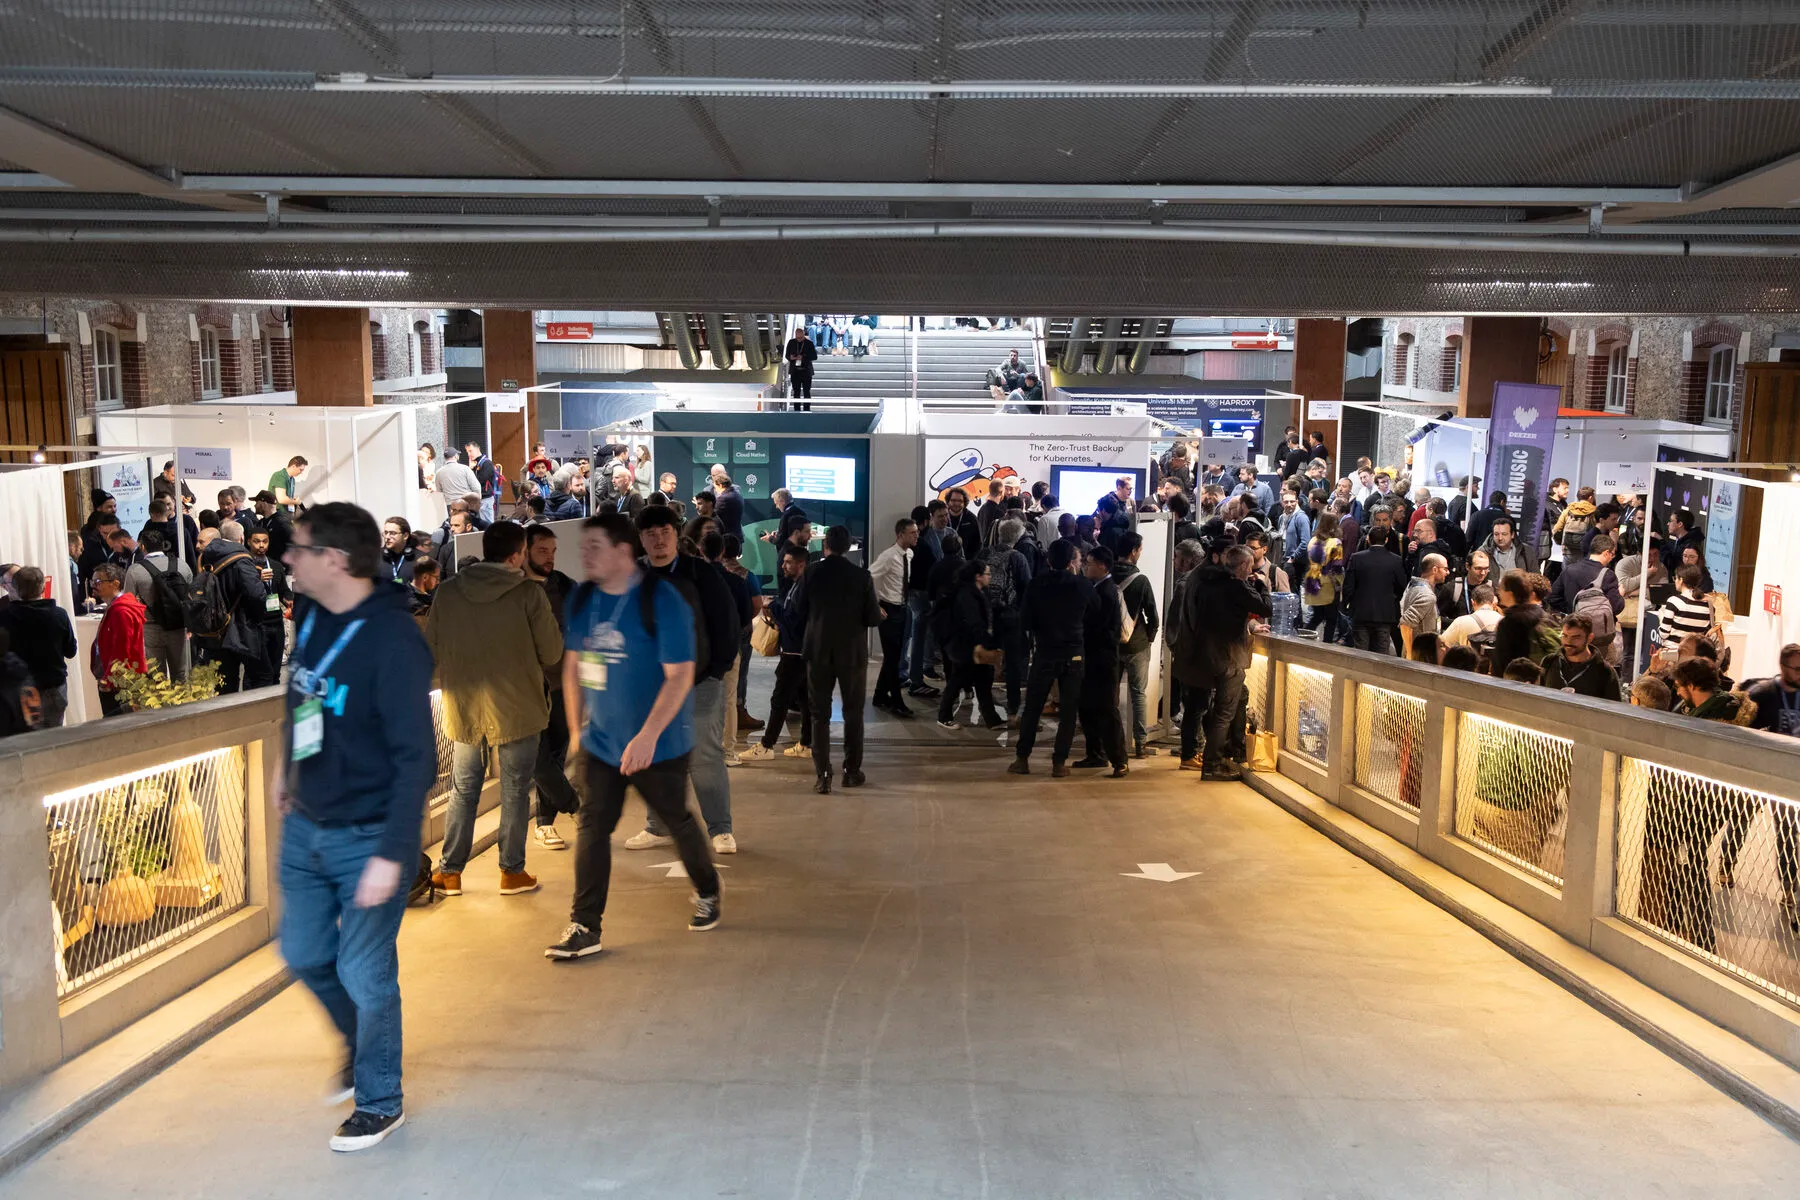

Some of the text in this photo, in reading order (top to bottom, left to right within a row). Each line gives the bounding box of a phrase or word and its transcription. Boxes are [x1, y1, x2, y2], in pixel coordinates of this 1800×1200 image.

[1508, 431, 1537, 439] DEEZER
[1029, 443, 1045, 452] The
[1092, 444, 1124, 453] Backup
[1029, 454, 1094, 463] for Kubernetes.
[1508, 449, 1529, 494] MUSIC
